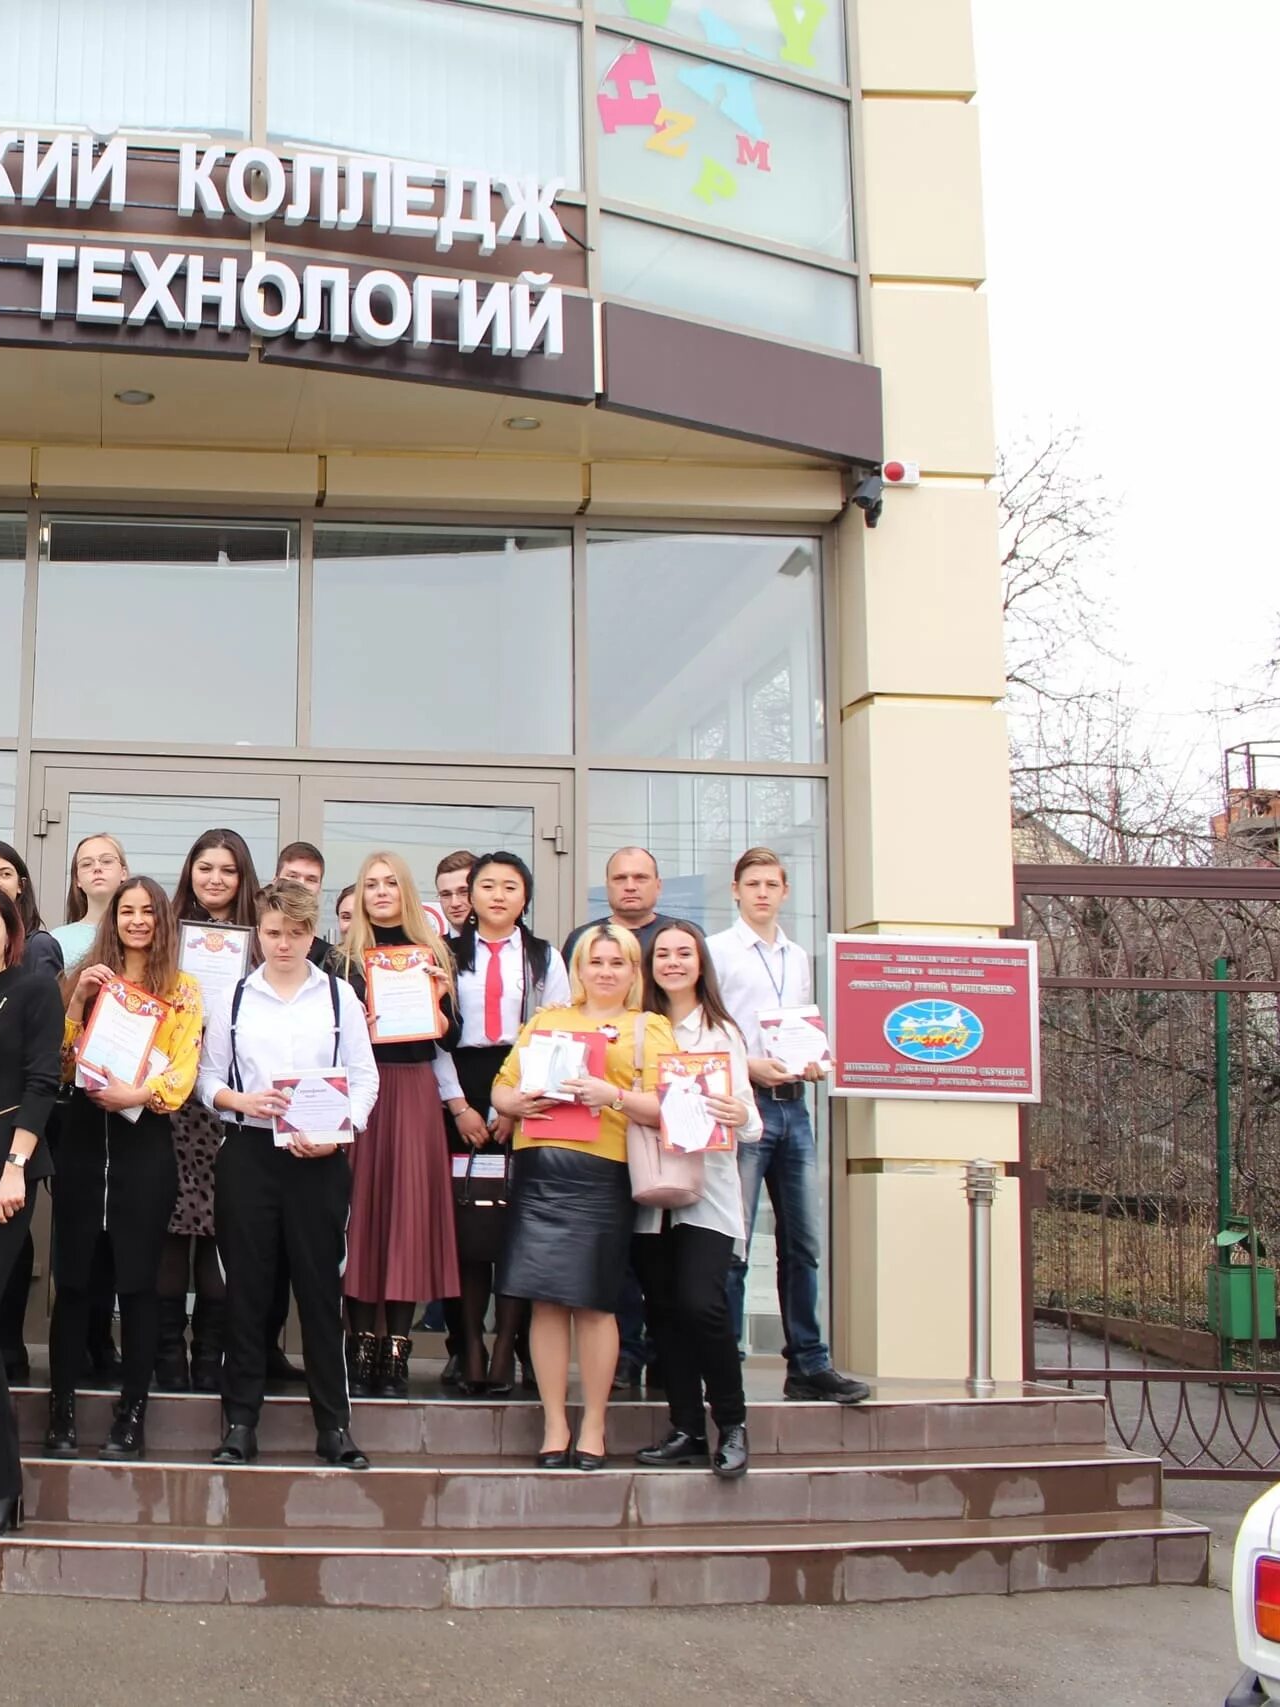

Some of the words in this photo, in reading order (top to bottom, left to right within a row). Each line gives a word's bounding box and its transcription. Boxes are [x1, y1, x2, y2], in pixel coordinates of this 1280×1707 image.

[177, 141, 568, 256] КОЛЛЕДЖ
[735, 133, 772, 172] M
[25, 243, 564, 358] ТЕХНОЛОГИЙ
